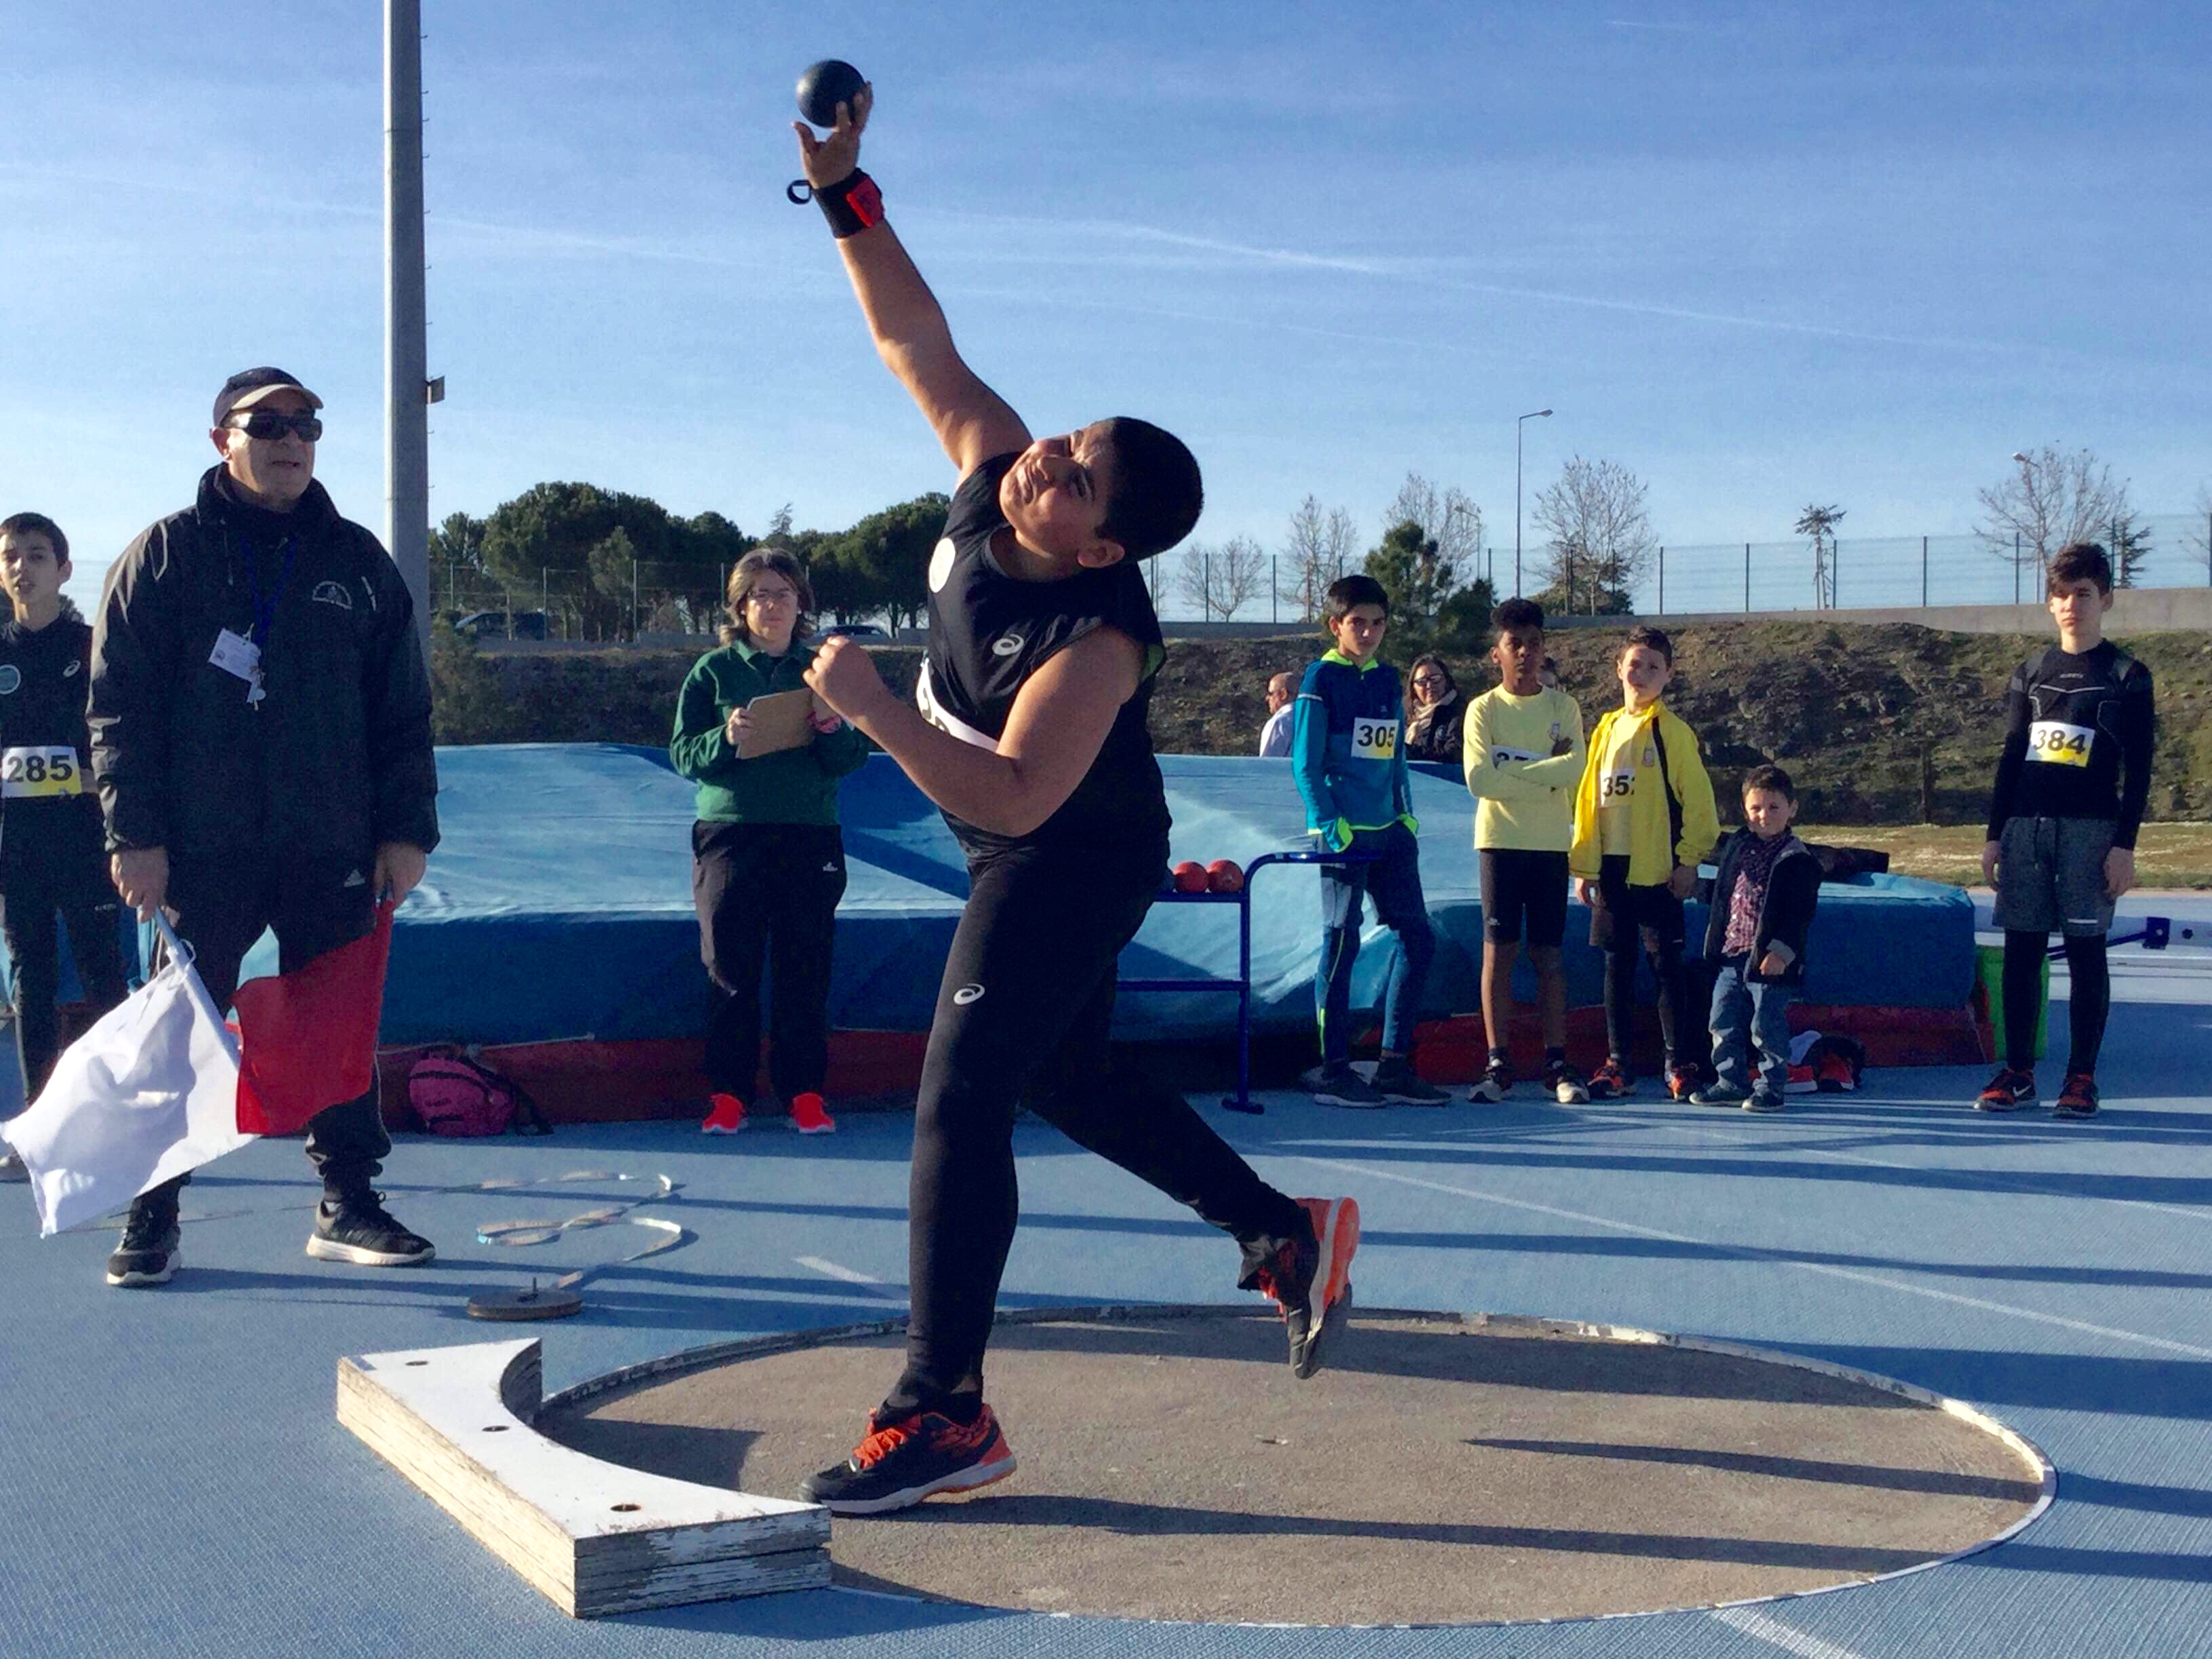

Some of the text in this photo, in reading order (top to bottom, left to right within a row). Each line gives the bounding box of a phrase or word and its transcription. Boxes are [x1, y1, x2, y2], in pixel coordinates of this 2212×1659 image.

[2033, 729, 2086, 754] 384
[7, 754, 73, 783] 285
[1602, 775, 1635, 797] 35
